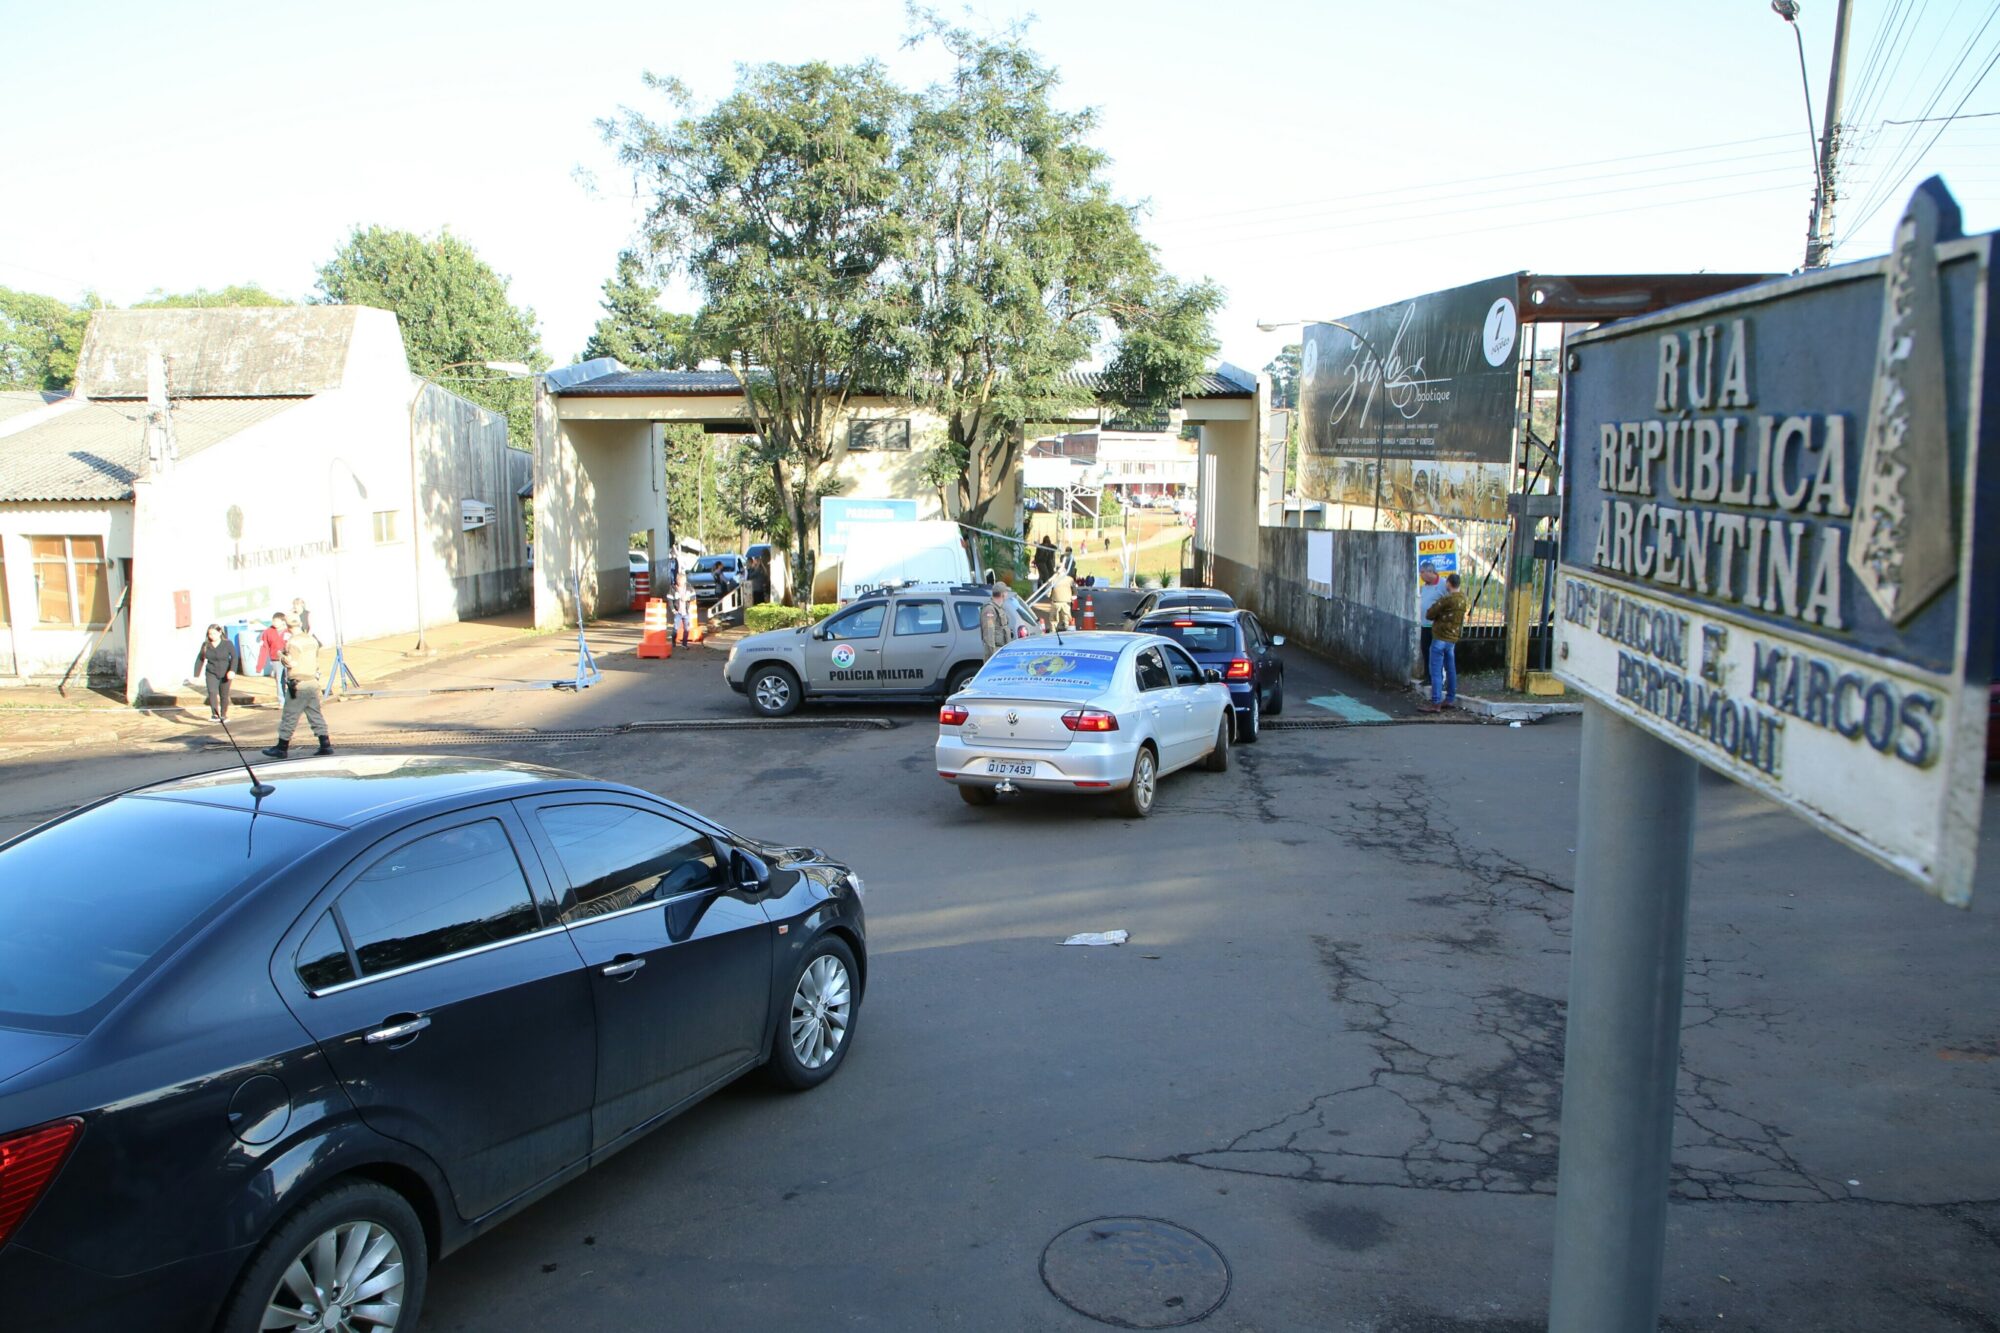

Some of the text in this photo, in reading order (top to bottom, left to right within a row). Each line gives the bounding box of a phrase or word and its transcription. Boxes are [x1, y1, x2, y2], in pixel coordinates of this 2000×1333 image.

[1416, 388, 1450, 404] boutique
[1655, 319, 1749, 411] RUA
[1599, 411, 1850, 516] REPÚBLICA
[1418, 538, 1455, 552] 06/07
[1593, 500, 1843, 630] ARGENTINA
[829, 668, 924, 681] POLÍCIA MILITAR
[1598, 586, 1690, 670] MAICON
[1700, 623, 1729, 687] E
[1751, 641, 1940, 768] MARCOS
[1615, 650, 1785, 780] BERTAMONI
